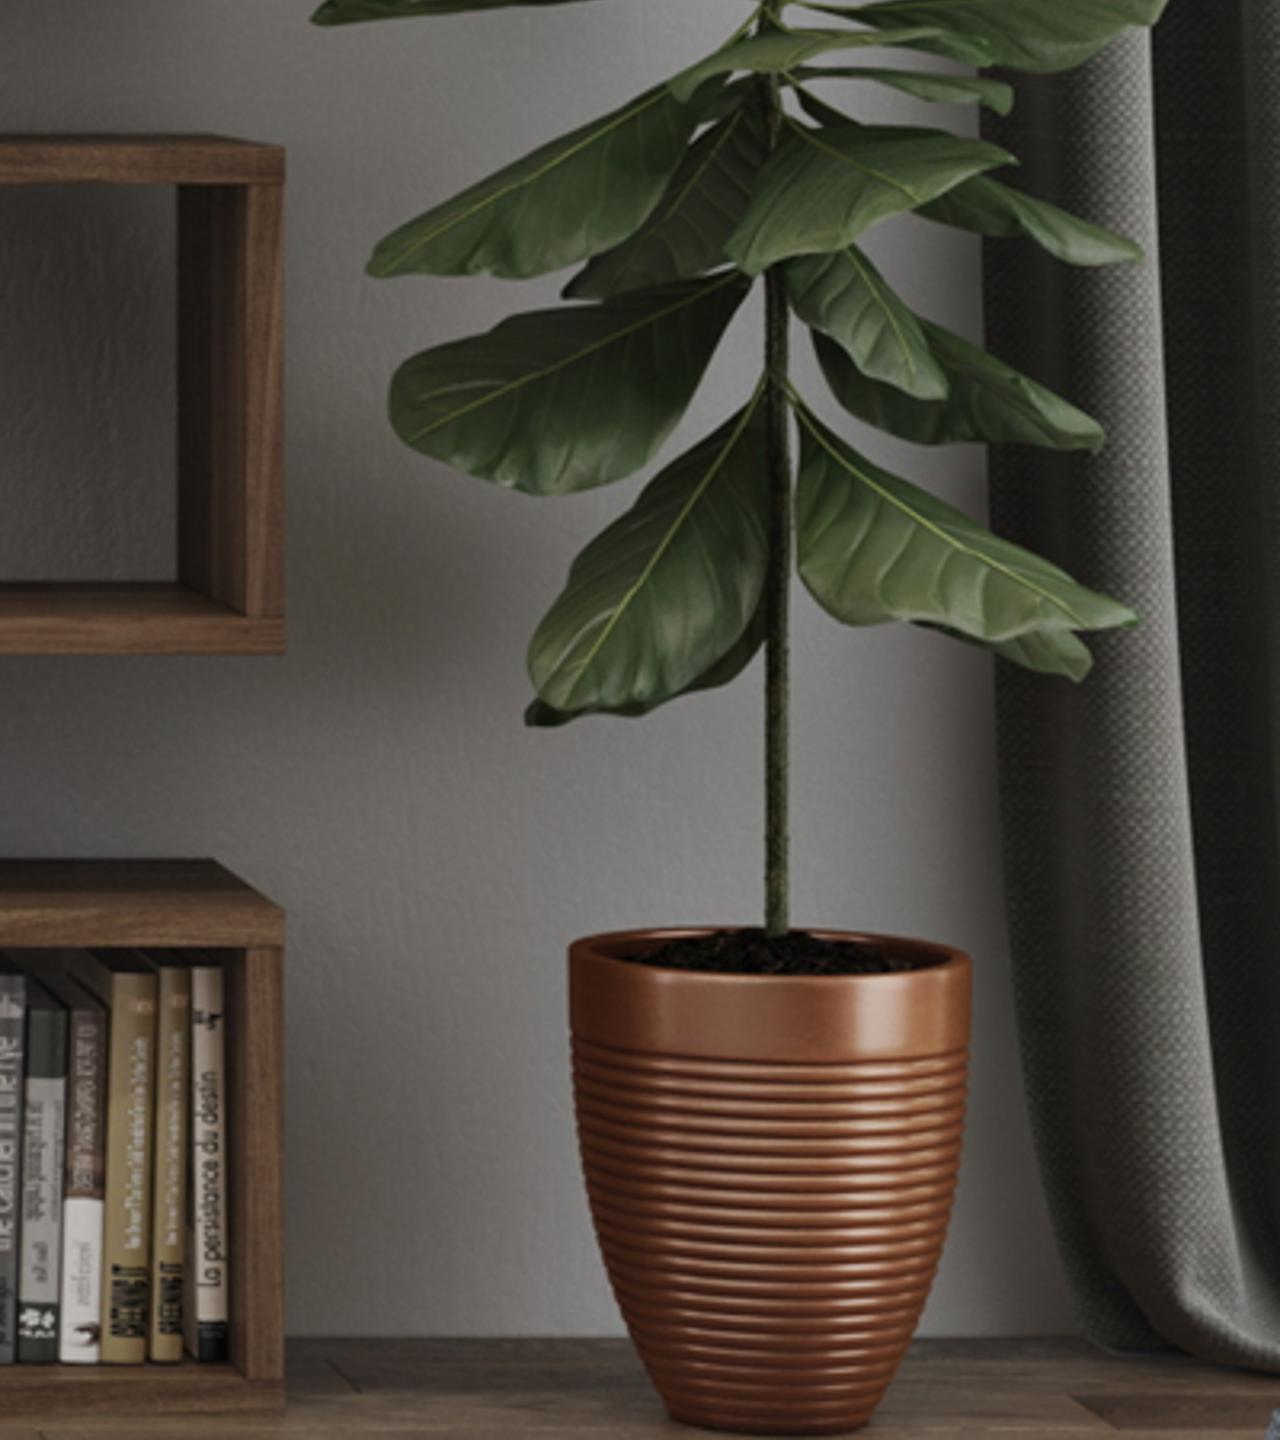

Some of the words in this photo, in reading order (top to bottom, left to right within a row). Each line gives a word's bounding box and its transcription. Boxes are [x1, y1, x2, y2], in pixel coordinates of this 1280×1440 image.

[196, 1071, 219, 1125] destin
[196, 1131, 219, 1154] du
[111, 1264, 148, 1277] IT
[159, 1262, 183, 1274] IT
